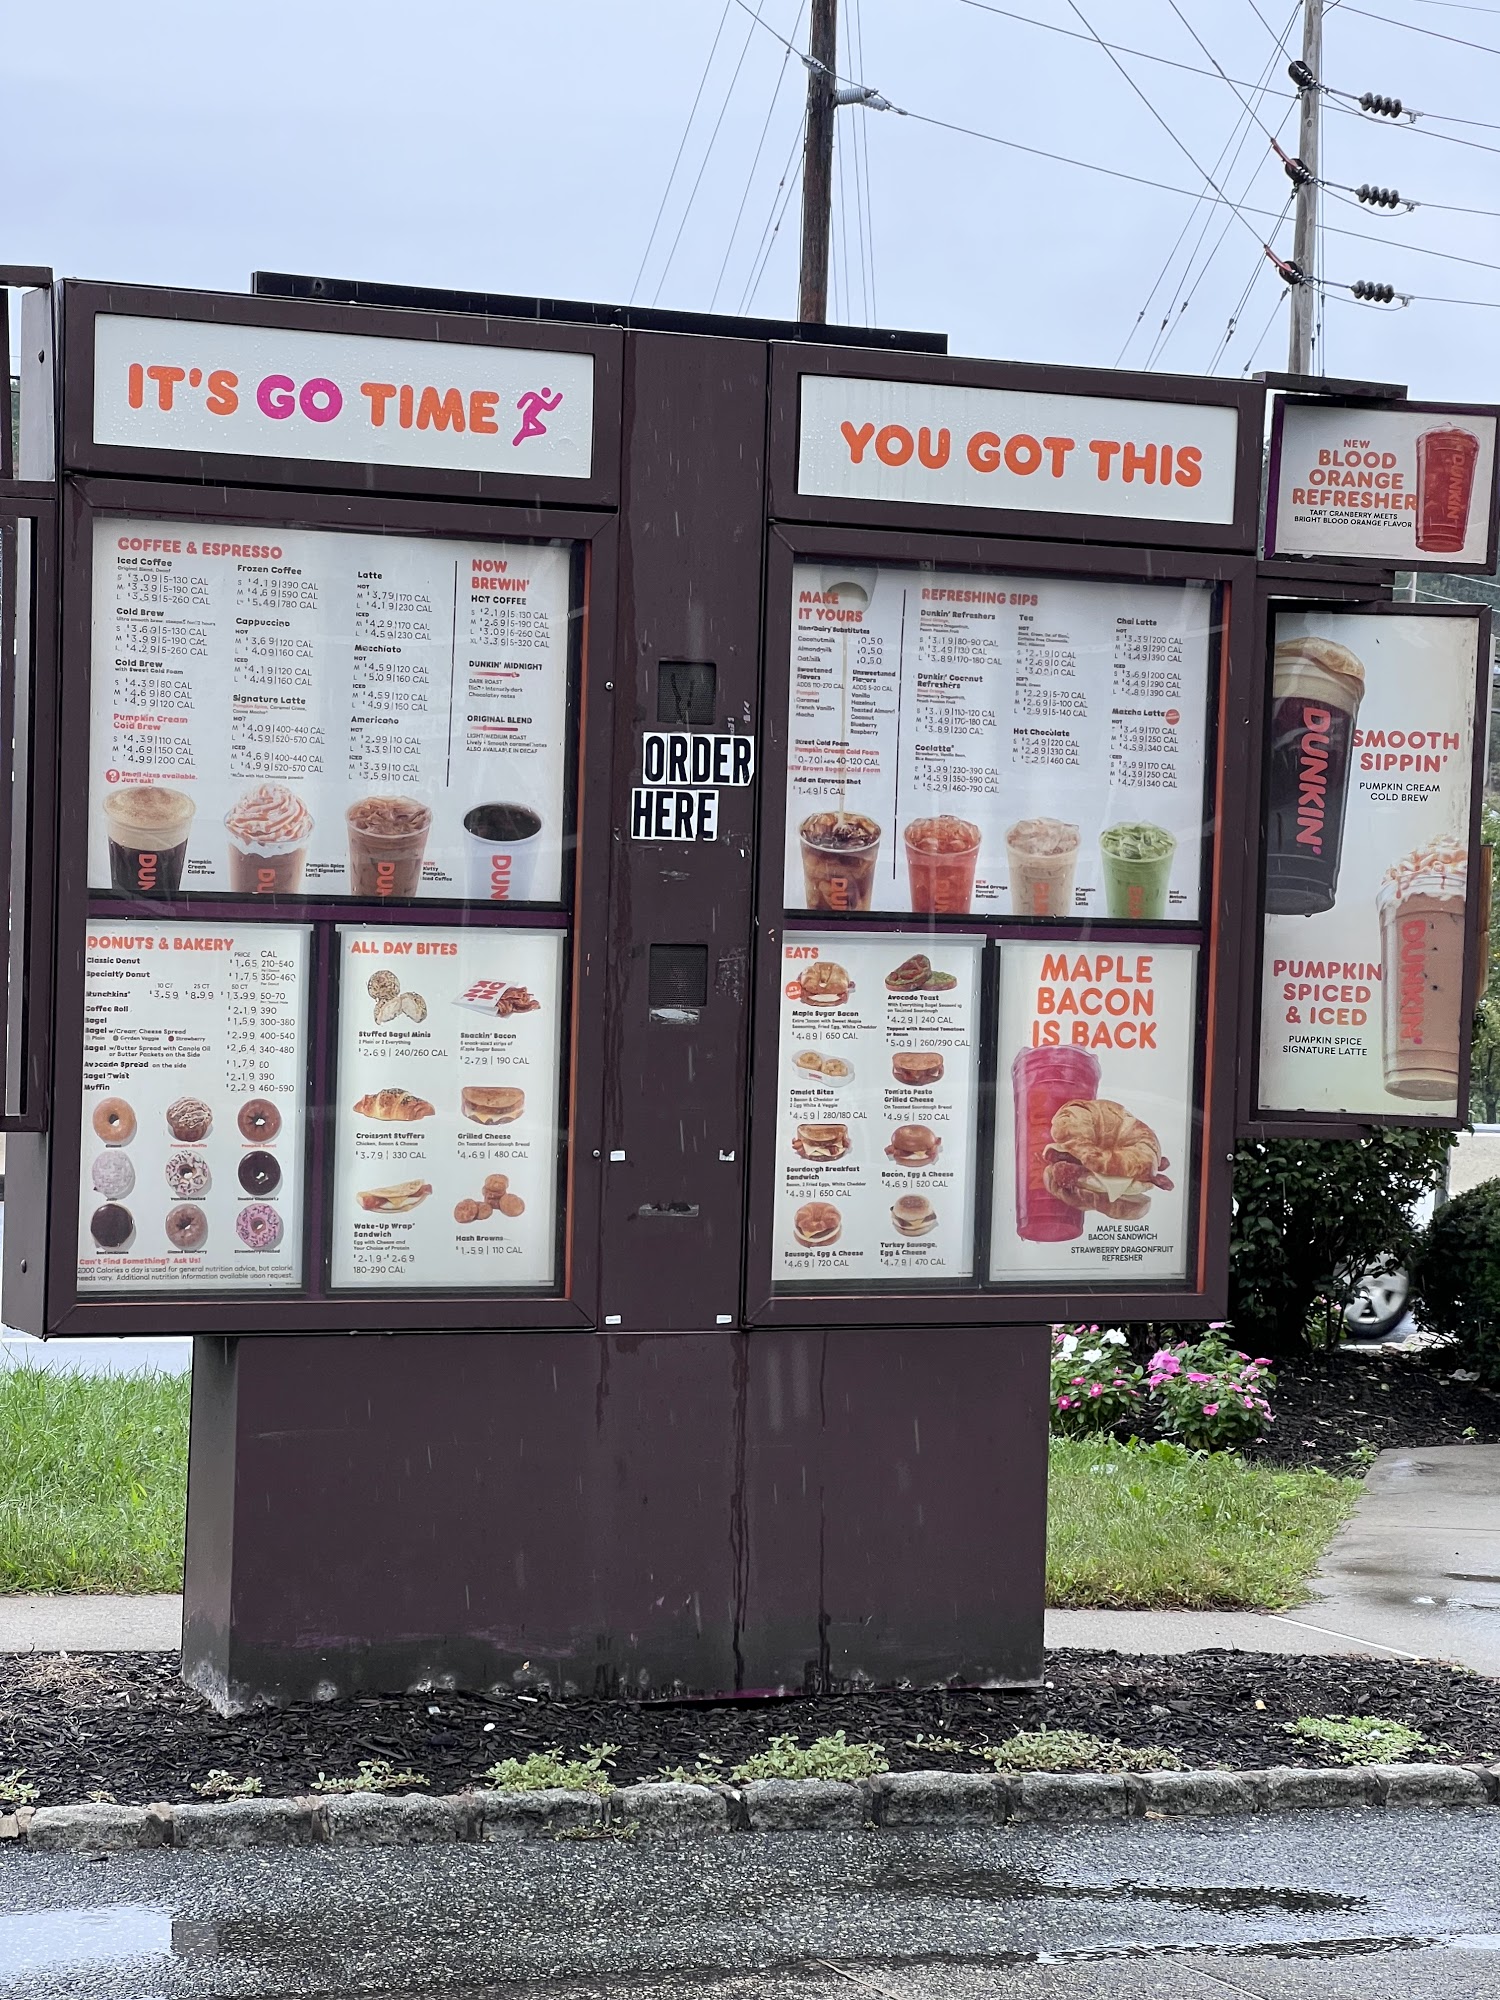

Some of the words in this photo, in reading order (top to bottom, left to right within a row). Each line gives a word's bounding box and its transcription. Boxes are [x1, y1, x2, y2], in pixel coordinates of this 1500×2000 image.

[128, 362, 239, 416] IT'S
[256, 374, 342, 422] GO
[360, 382, 499, 434] TIME
[1344, 440, 1370, 448] NEW
[840, 420, 951, 469] YOU
[967, 431, 1075, 478] GOT
[1089, 439, 1203, 487] THIS
[1319, 449, 1396, 469] BLOOD
[1309, 469, 1404, 489] ORANGE
[1293, 488, 1417, 510] REFRESHER
[1329, 510, 1372, 519] CRANBERRY
[1295, 516, 1321, 524] BRIGHT
[1384, 520, 1412, 528] FLAVOR
[118, 537, 181, 554] COFFEE
[187, 542, 197, 554] &
[202, 543, 282, 559] ESPRESSO
[117, 557, 137, 565] Iced
[141, 559, 172, 567] Coffee
[472, 559, 507, 573] NOW
[238, 565, 268, 573] Frozen
[271, 566, 301, 575] Coffee
[358, 571, 382, 580] Latte
[471, 577, 530, 592] BREWIN'
[471, 595, 490, 603] HOT
[493, 597, 526, 605] COFFEE
[799, 591, 839, 605] MAKE
[922, 588, 1006, 604] REFRESHING
[1009, 593, 1038, 606] SIPS
[117, 608, 138, 616] Cold
[141, 609, 164, 617] Brew
[799, 608, 813, 620] IT
[816, 609, 863, 623] YOURS
[953, 611, 995, 620] Refreshers
[236, 618, 290, 628] Cappuccino
[115, 659, 137, 667] Cold
[139, 660, 162, 668] Brew
[504, 662, 542, 670] MIDNIGHT
[233, 695, 278, 704] Signature
[280, 696, 306, 705] Latte
[1144, 709, 1165, 717] Latte
[114, 714, 154, 724] Pumpkin
[157, 715, 188, 723] Cream
[351, 716, 399, 724] Americano
[467, 715, 505, 723] ORIGINAL
[507, 716, 532, 724] BLEND
[114, 722, 135, 730] Cold
[1030, 729, 1069, 737] Chocolate
[1353, 730, 1459, 750] SMOOTH
[646, 737, 752, 783] ORDER
[1360, 753, 1448, 773] SIPPIN'
[1296, 707, 1330, 855] DUNKIN'
[1360, 782, 1402, 791] PUMPKIN
[1406, 784, 1441, 792] CREAM
[1371, 793, 1398, 801] COLD
[1402, 794, 1428, 802] BREW
[633, 791, 713, 838] HERE
[87, 936, 153, 950] DONUTS
[159, 938, 168, 950] &
[174, 938, 234, 951] BAKERY
[351, 941, 379, 954] ALL
[384, 942, 412, 954] DAY
[416, 943, 457, 955] BITES
[261, 950, 277, 958] CAL
[785, 947, 819, 959] EATS
[87, 957, 113, 965] Classic
[1041, 954, 1153, 983] MAPLE
[1274, 960, 1382, 981] PUMPKIN
[1283, 983, 1371, 1003] SPICED
[1037, 987, 1154, 1017] BACON
[1286, 1006, 1301, 1024] &
[1310, 1007, 1367, 1025] ICED
[1032, 1020, 1060, 1048] IS
[1072, 1021, 1157, 1049] BACK
[1289, 1036, 1333, 1044] PUMPKIN
[1335, 1037, 1362, 1045] SPICE
[395, 1049, 429, 1057] 240/260
[1282, 1045, 1336, 1054] SIGNATURE
[1339, 1047, 1367, 1056] LATTE
[497, 1057, 510, 1065] 190
[512, 1057, 529, 1065] CAL
[392, 1151, 407, 1159] 330
[409, 1151, 426, 1159] CAL
[1097, 1225, 1121, 1233] MAPLE
[1124, 1225, 1149, 1233] SUGAR
[1088, 1233, 1114, 1241] BACON
[493, 1246, 504, 1254] 110
[506, 1246, 522, 1254] CAL
[1071, 1246, 1119, 1255] STRAWBERRY
[1101, 1254, 1143, 1262] REFRESHER
